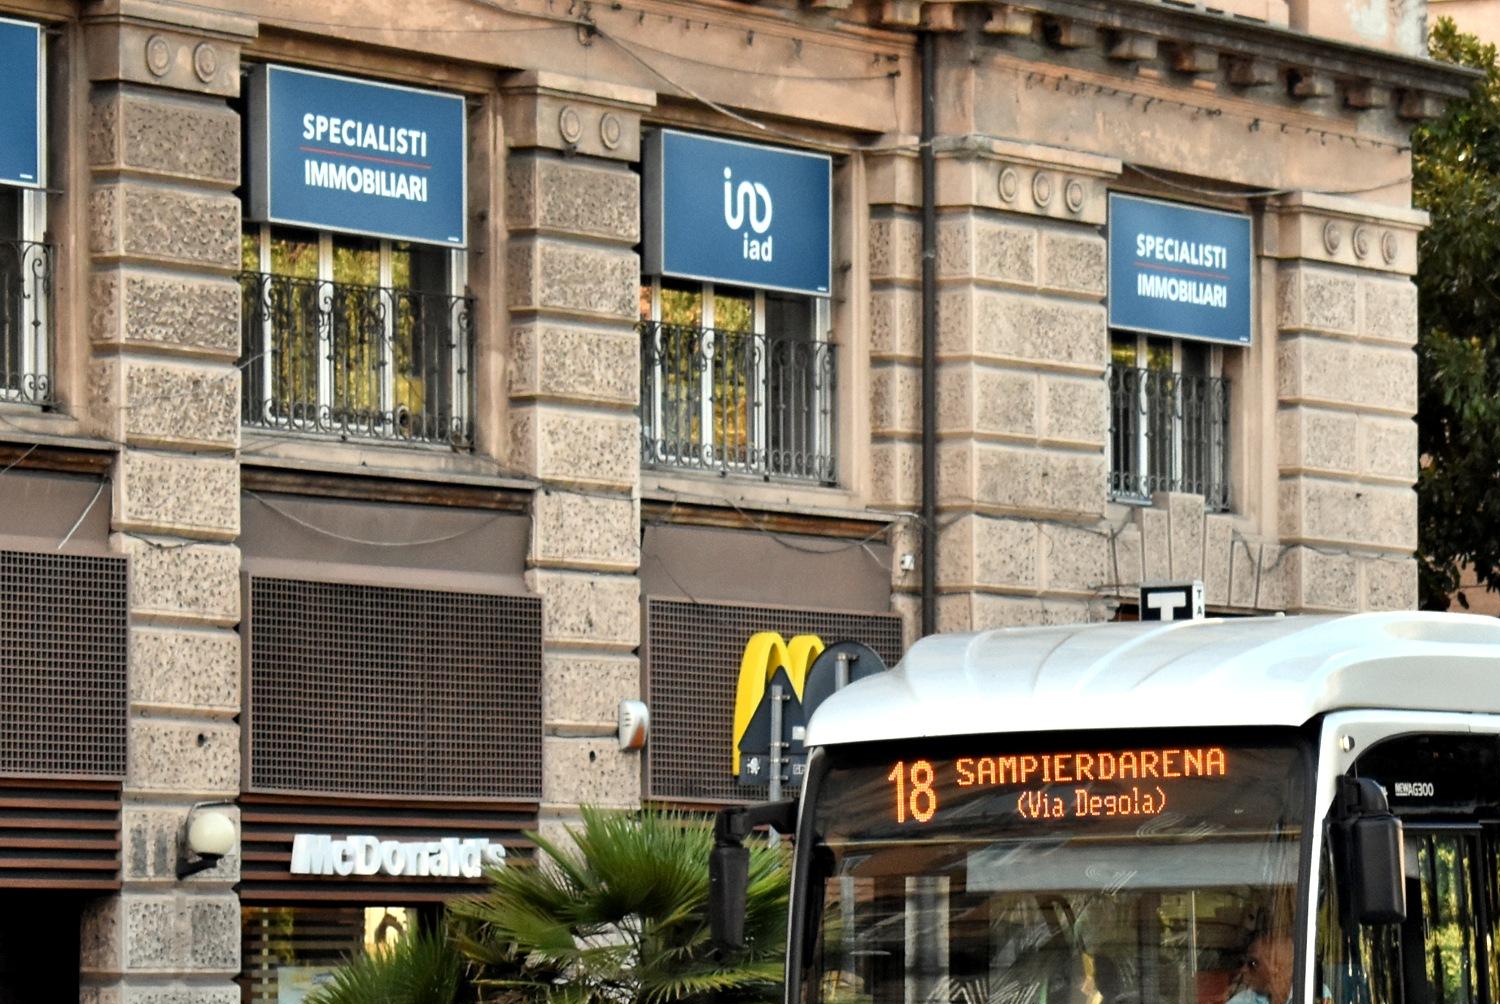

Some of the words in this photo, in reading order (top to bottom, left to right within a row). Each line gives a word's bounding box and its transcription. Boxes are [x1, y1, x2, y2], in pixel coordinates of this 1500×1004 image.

[303, 112, 427, 157] SPECIALISTI
[304, 159, 428, 202] IMMOBILIARI
[743, 231, 773, 262] iad
[1136, 233, 1227, 269] SPECIALISTI
[1137, 273, 1227, 308] IMMOBILIARI
[888, 760, 938, 823] 18
[956, 748, 1226, 786] SAMPIERDARENA
[1017, 790, 1065, 819] (Via
[1074, 785, 1167, 817] Degola)
[290, 833, 507, 877] McDonald's
